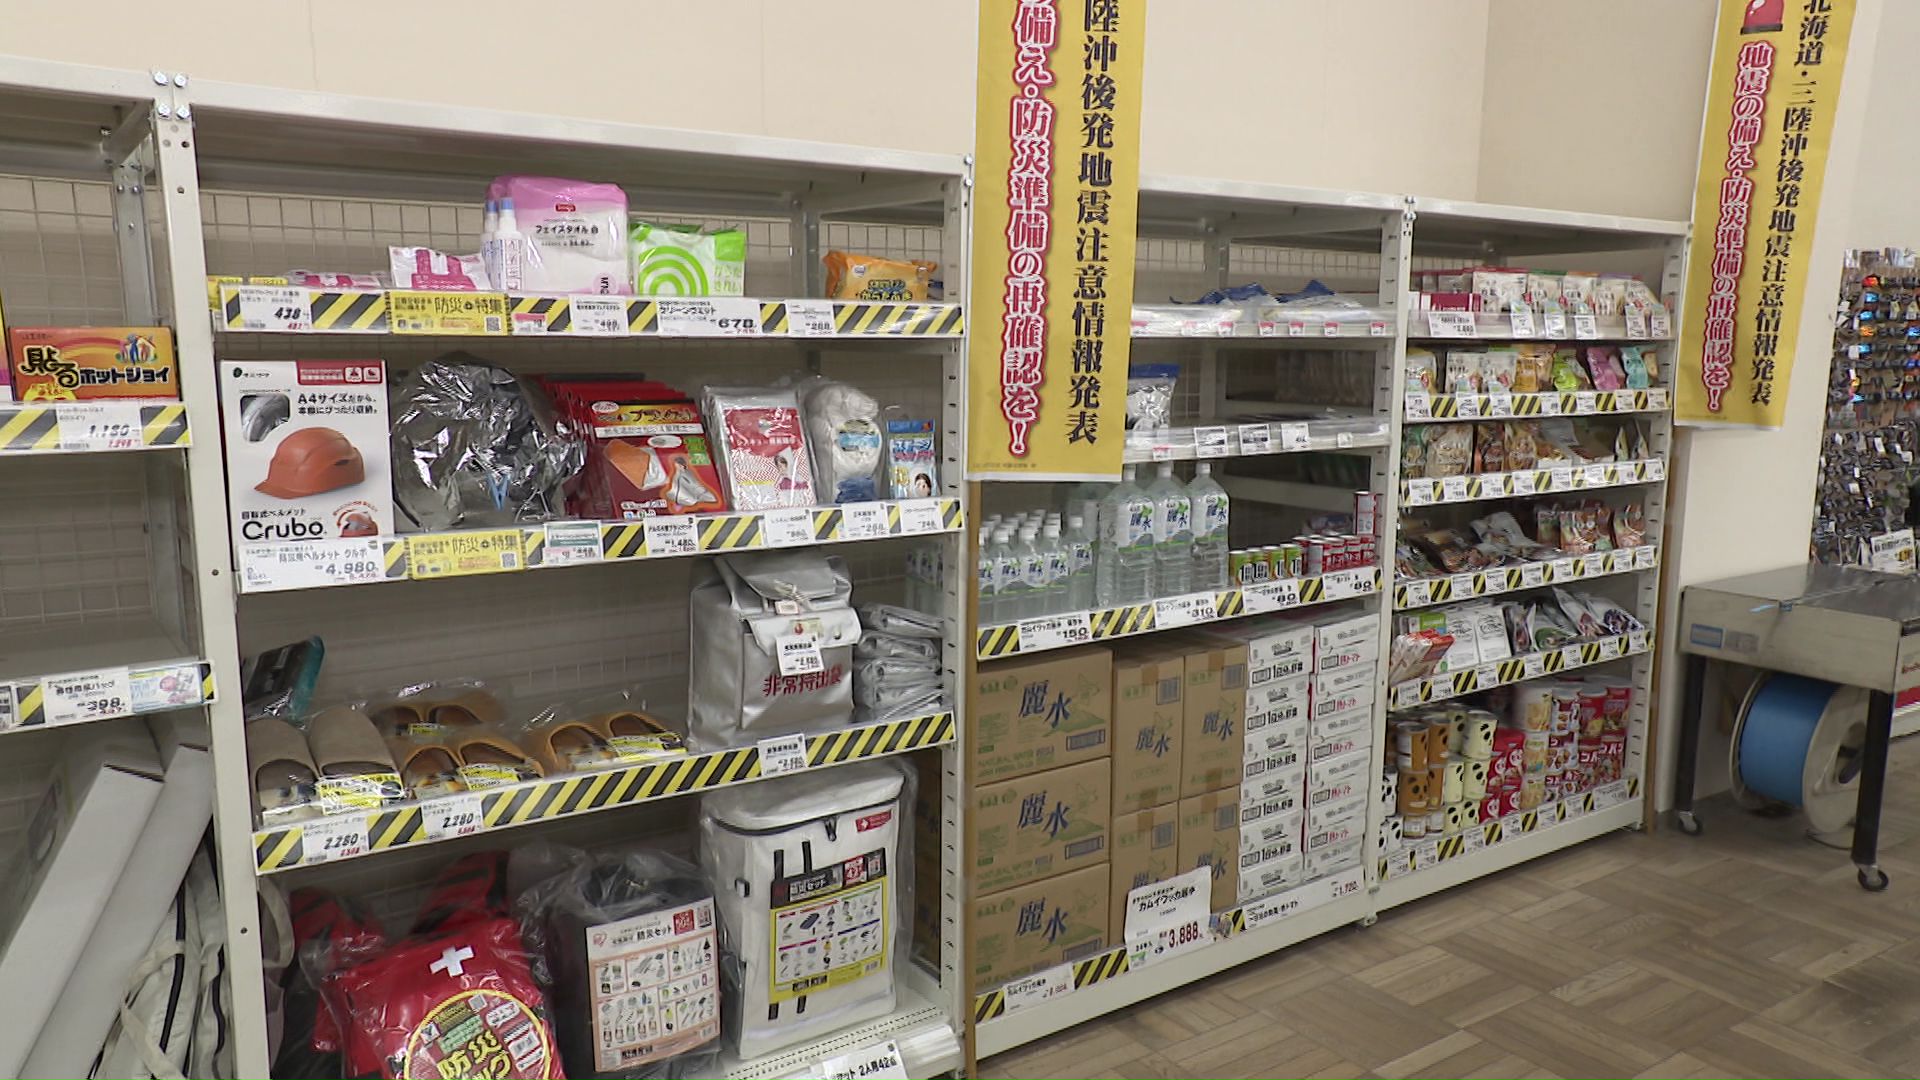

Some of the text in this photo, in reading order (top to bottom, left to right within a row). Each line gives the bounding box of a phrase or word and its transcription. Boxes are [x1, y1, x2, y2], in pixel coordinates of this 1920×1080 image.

[1002, 0, 1056, 454] 備え・防災準備の再確認を!
[434, 297, 463, 314] 防災
[717, 318, 754, 329] 678
[242, 517, 324, 540] Crubo
[451, 537, 480, 554] 防災
[1018, 679, 1072, 729] 麗水
[1135, 724, 1172, 758] 麗水
[1202, 709, 1234, 742] 麗水
[1017, 790, 1070, 838] 麗水
[1016, 896, 1069, 943] 麗水
[1168, 921, 1199, 948] 3,888
